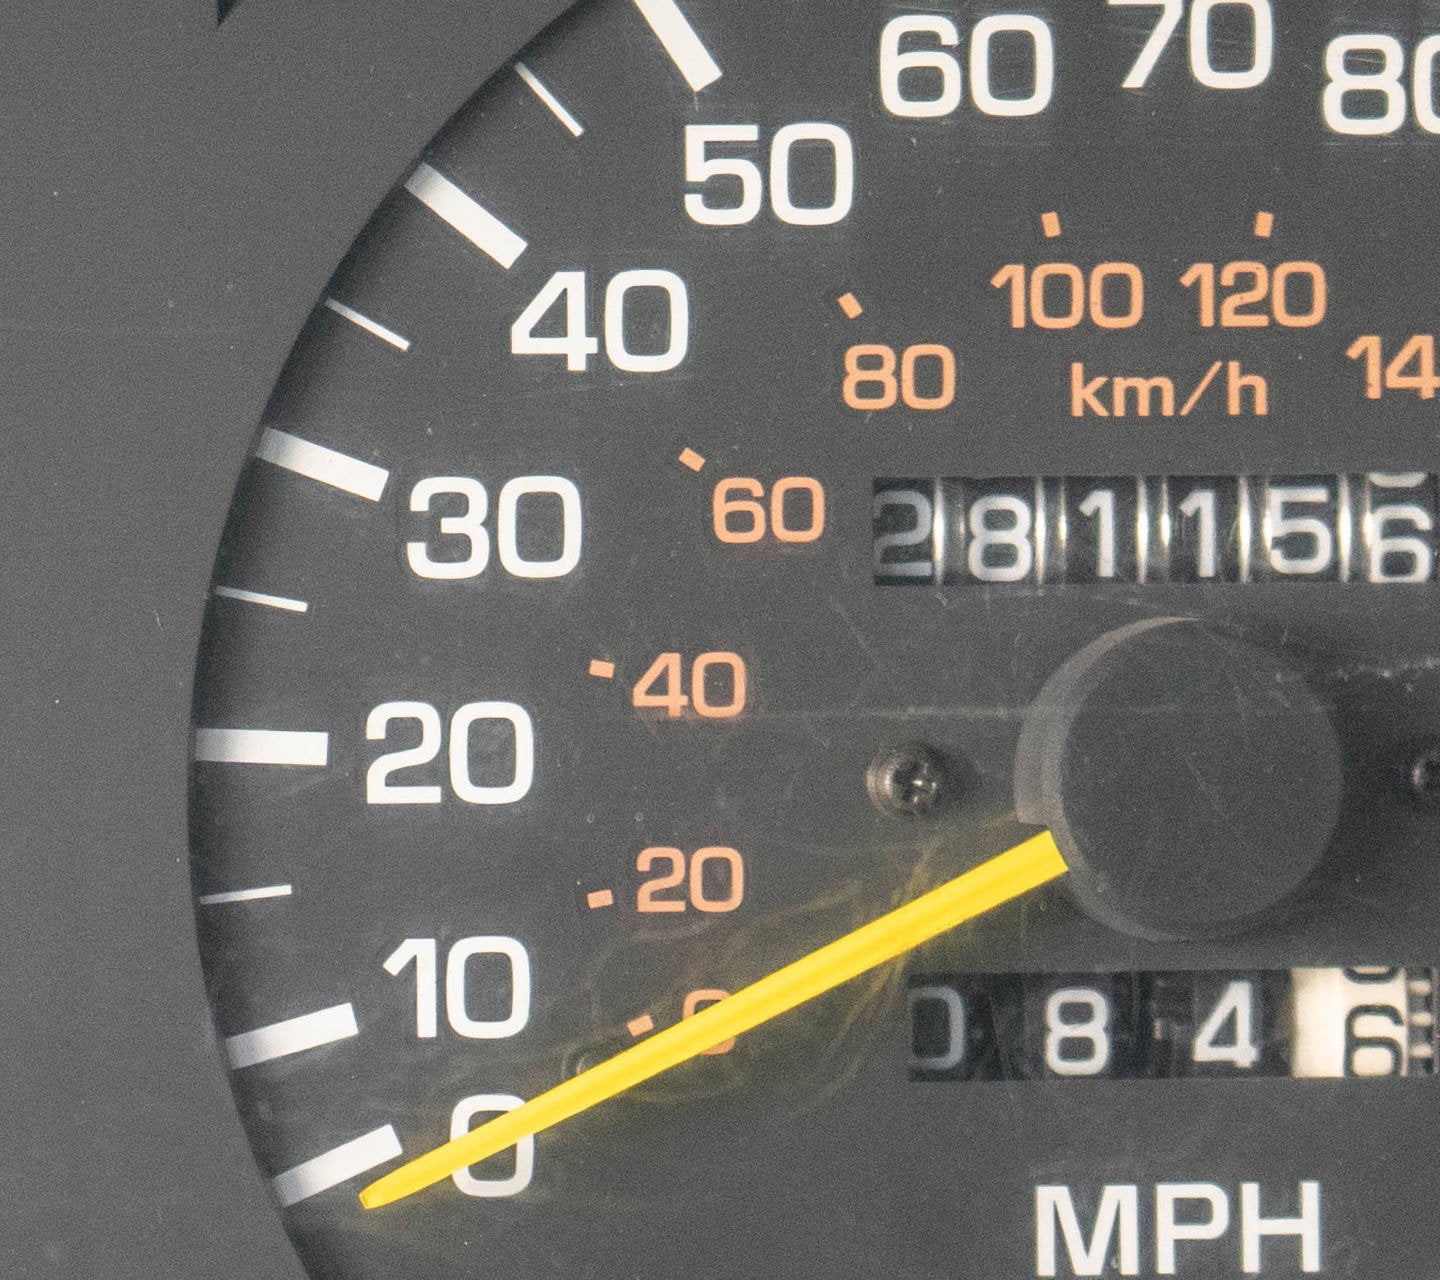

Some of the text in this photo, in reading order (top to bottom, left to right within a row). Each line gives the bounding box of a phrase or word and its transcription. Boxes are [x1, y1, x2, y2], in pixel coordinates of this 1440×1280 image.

[879, 14, 1054, 117] 60
[683, 123, 854, 226] 50
[511, 269, 689, 373] 40
[990, 261, 1144, 329] 100
[1180, 261, 1327, 328] 120
[843, 344, 956, 410] 80
[1070, 361, 1269, 417] km/h
[407, 475, 583, 580] 30
[713, 477, 825, 544] 60
[631, 651, 747, 718] 40
[365, 701, 535, 806] 20
[635, 846, 745, 913] 20
[383, 936, 531, 1039] 10
[449, 1094, 535, 1198] 0
[1035, 1180, 1322, 1277] MPH
